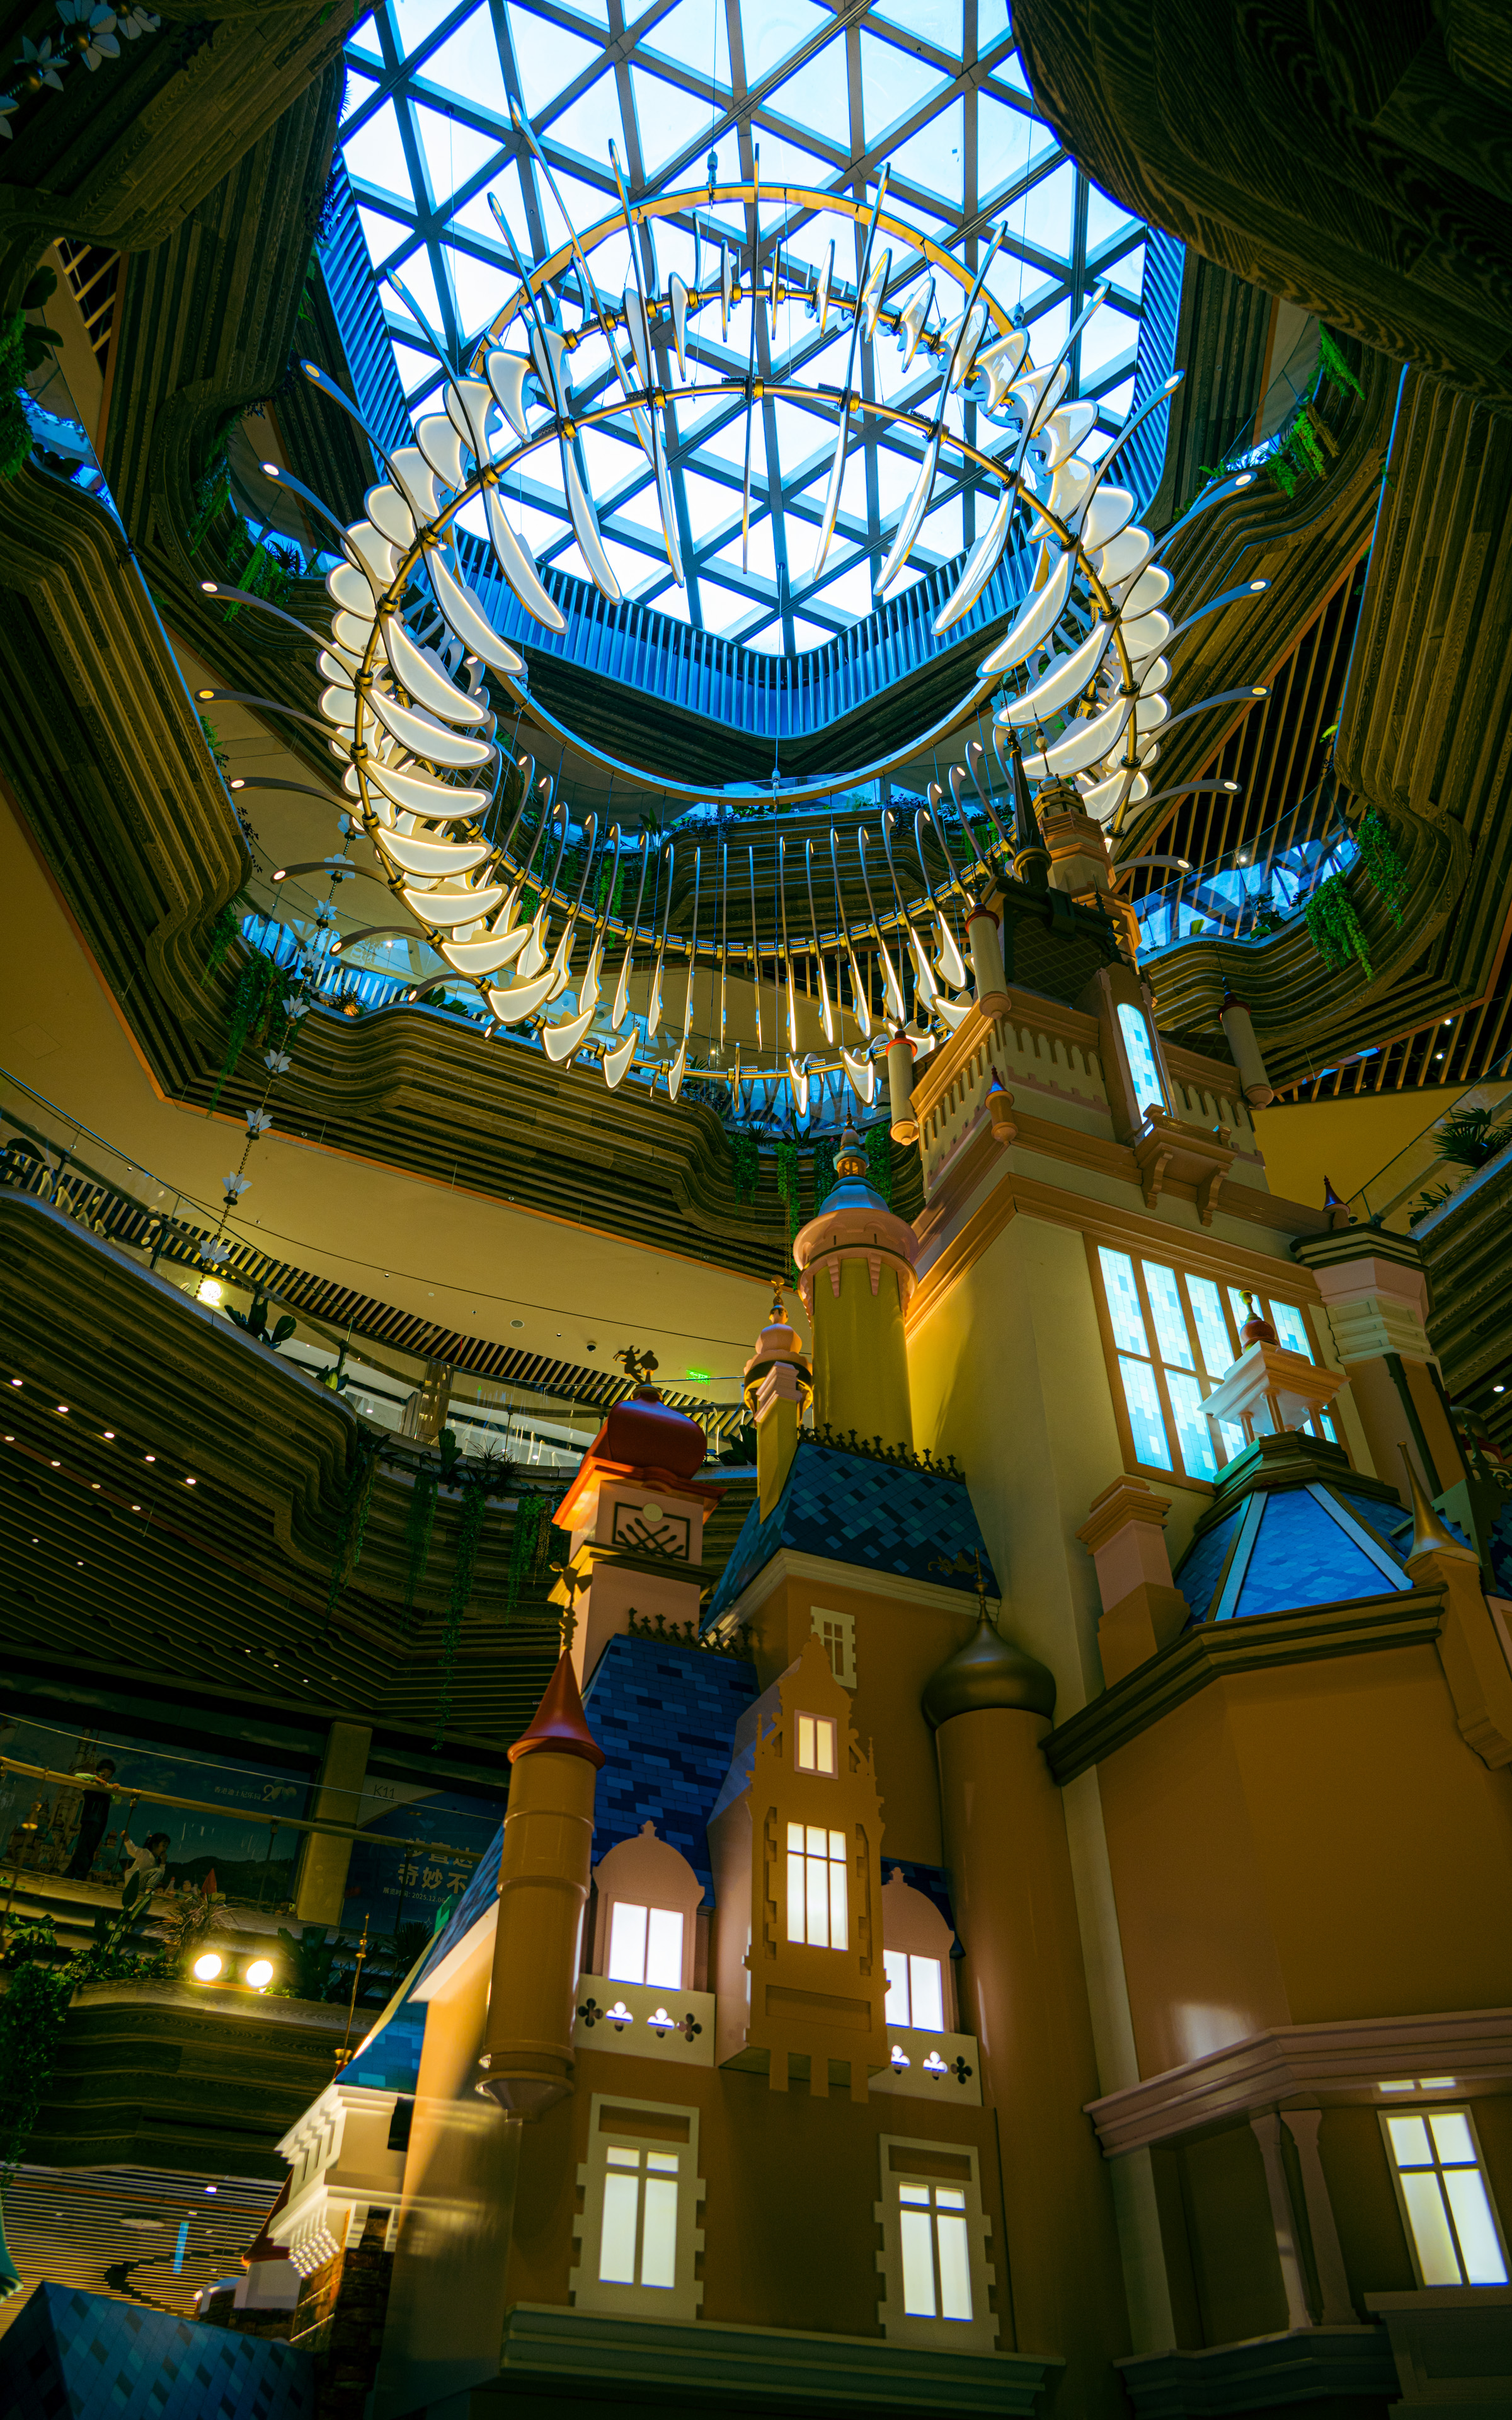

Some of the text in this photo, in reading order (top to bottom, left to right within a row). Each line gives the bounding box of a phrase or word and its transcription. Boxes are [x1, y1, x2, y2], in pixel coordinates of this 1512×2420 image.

[214, 1786, 261, 1801] 香港迪士尼乐园
[374, 1784, 394, 1799] K11
[398, 1864, 469, 1894] 奇妙不
